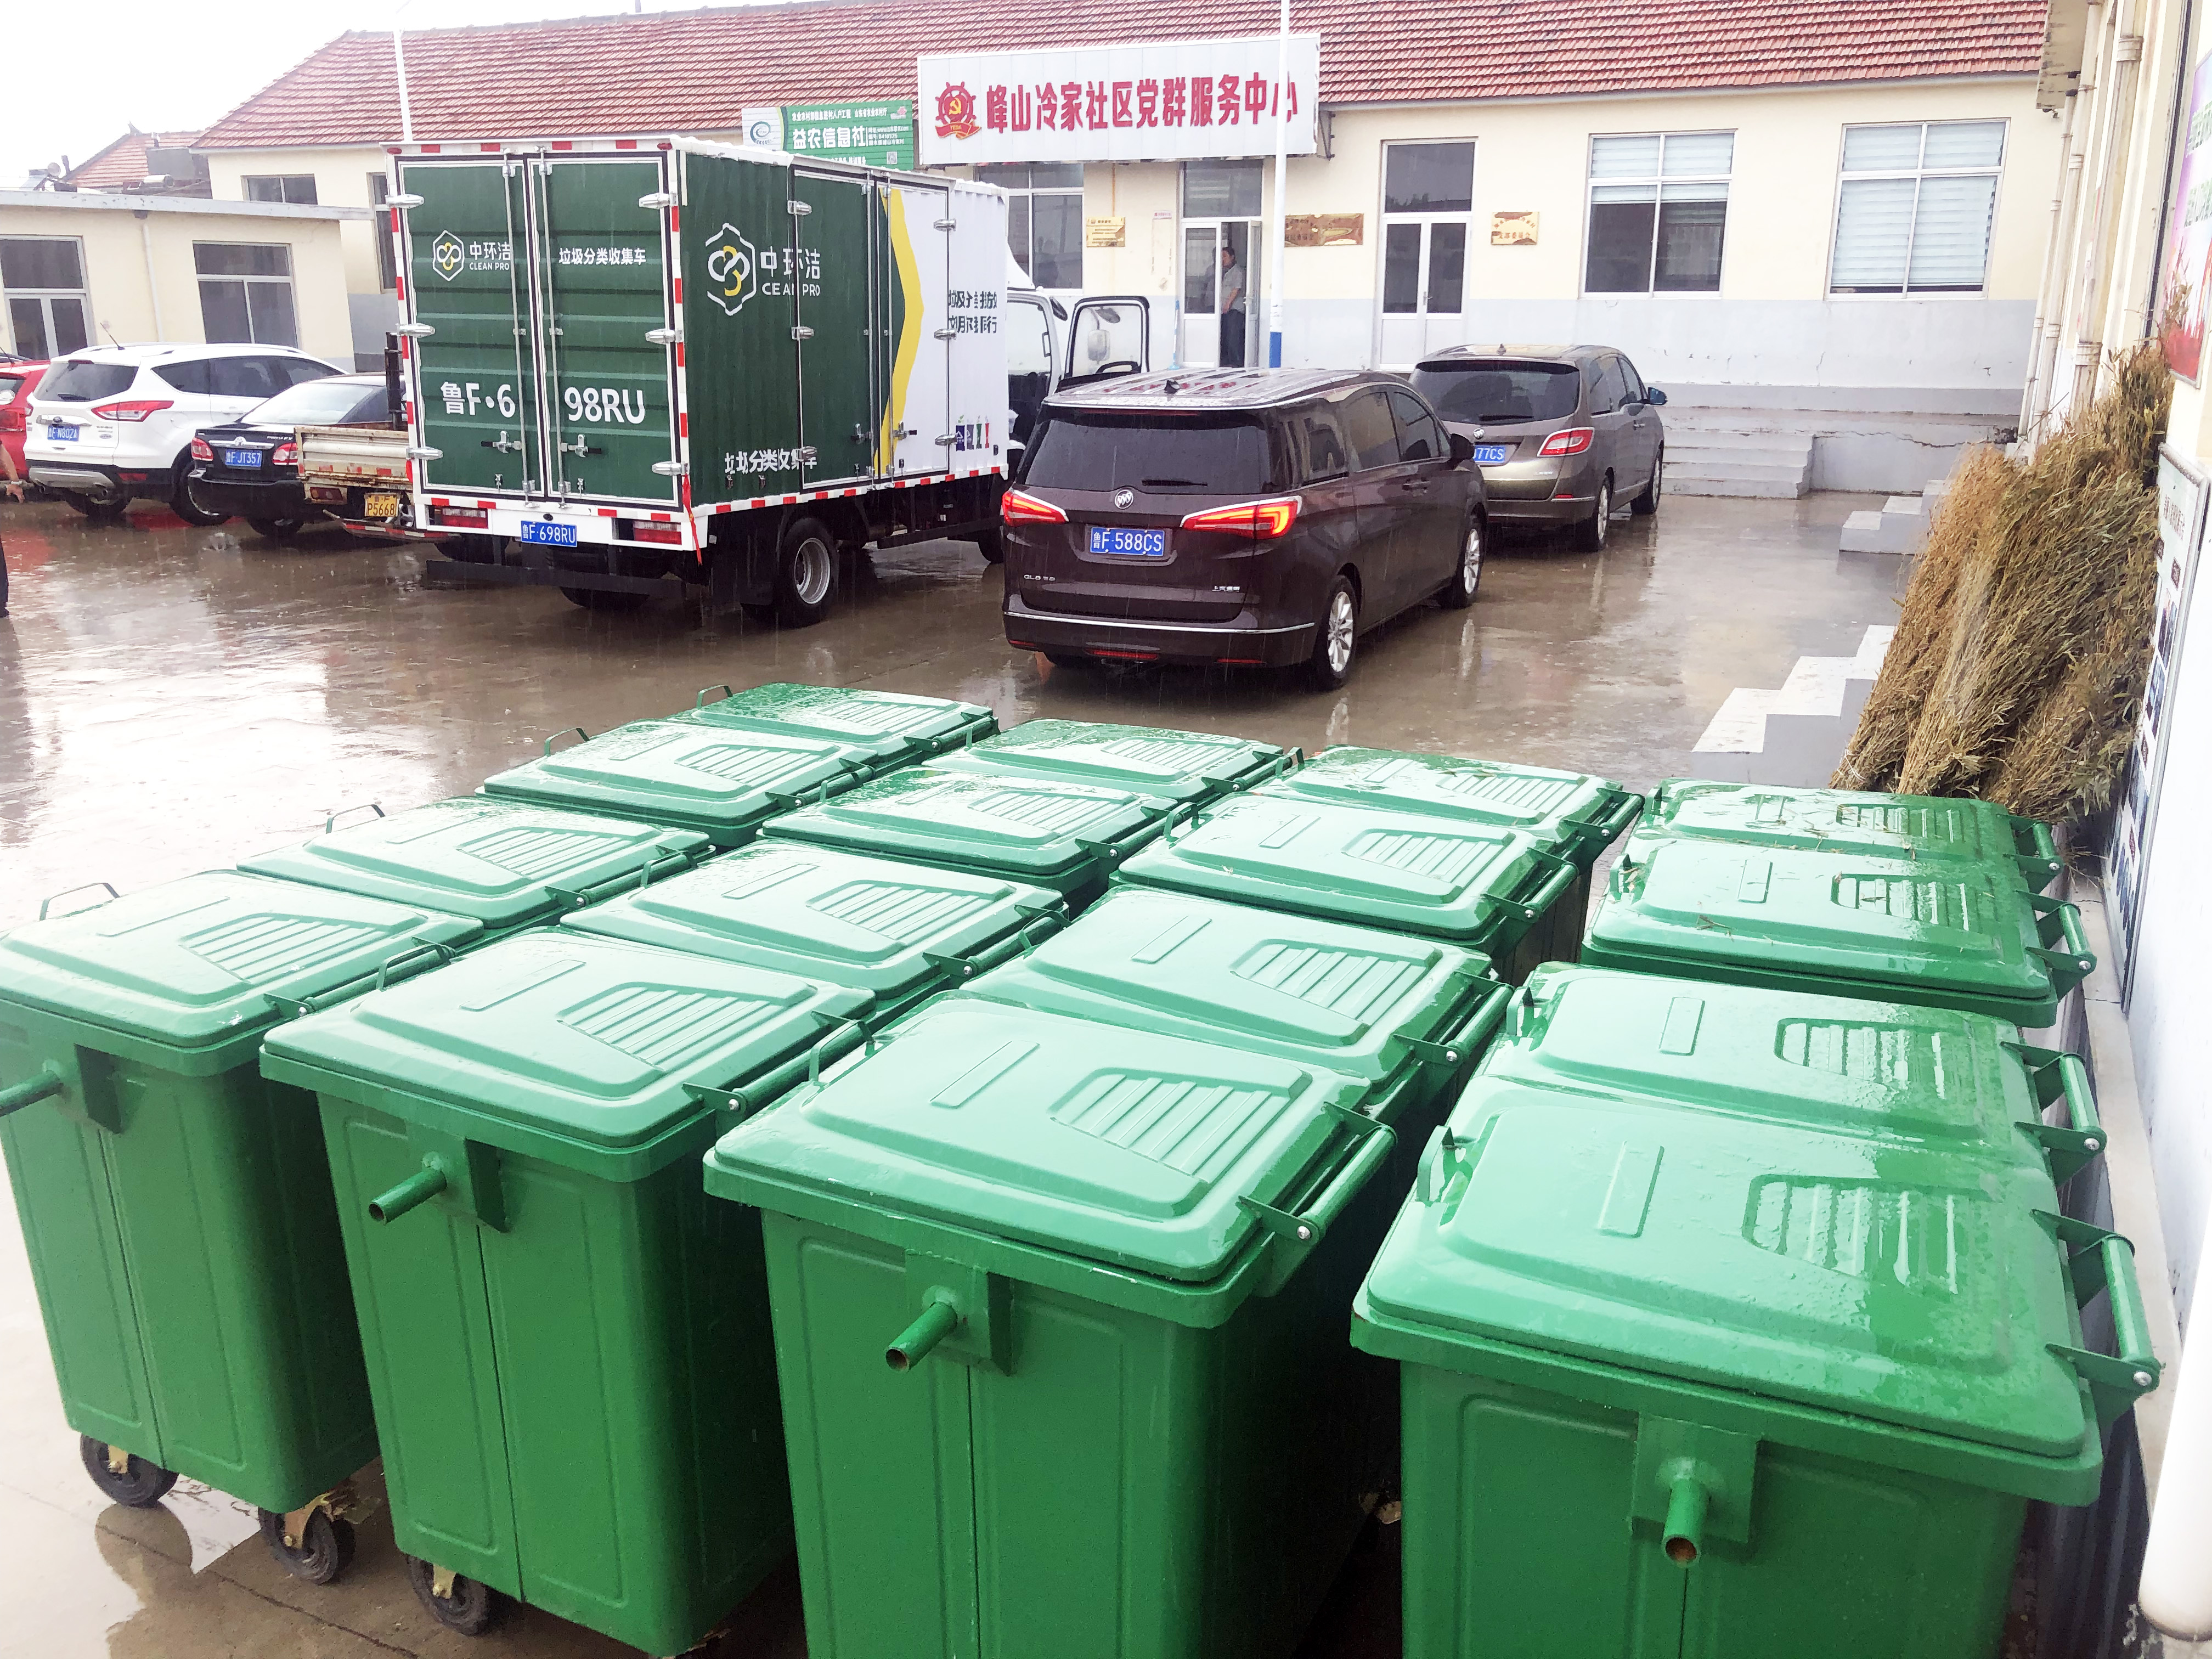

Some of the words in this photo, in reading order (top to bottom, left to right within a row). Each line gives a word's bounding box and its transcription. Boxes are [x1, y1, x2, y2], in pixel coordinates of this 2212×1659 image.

[987, 71, 1298, 134] 峰山冷家社区党群服务中心
[793, 125, 866, 150] 益农信息社
[470, 241, 511, 261] 中环洁
[558, 247, 646, 266] 垃圾分类收集车
[469, 262, 494, 270] CLEAN
[495, 262, 510, 270] PRO
[760, 245, 821, 279] 中环洁
[802, 283, 821, 297] PRO
[368, 503, 395, 516] P5668
